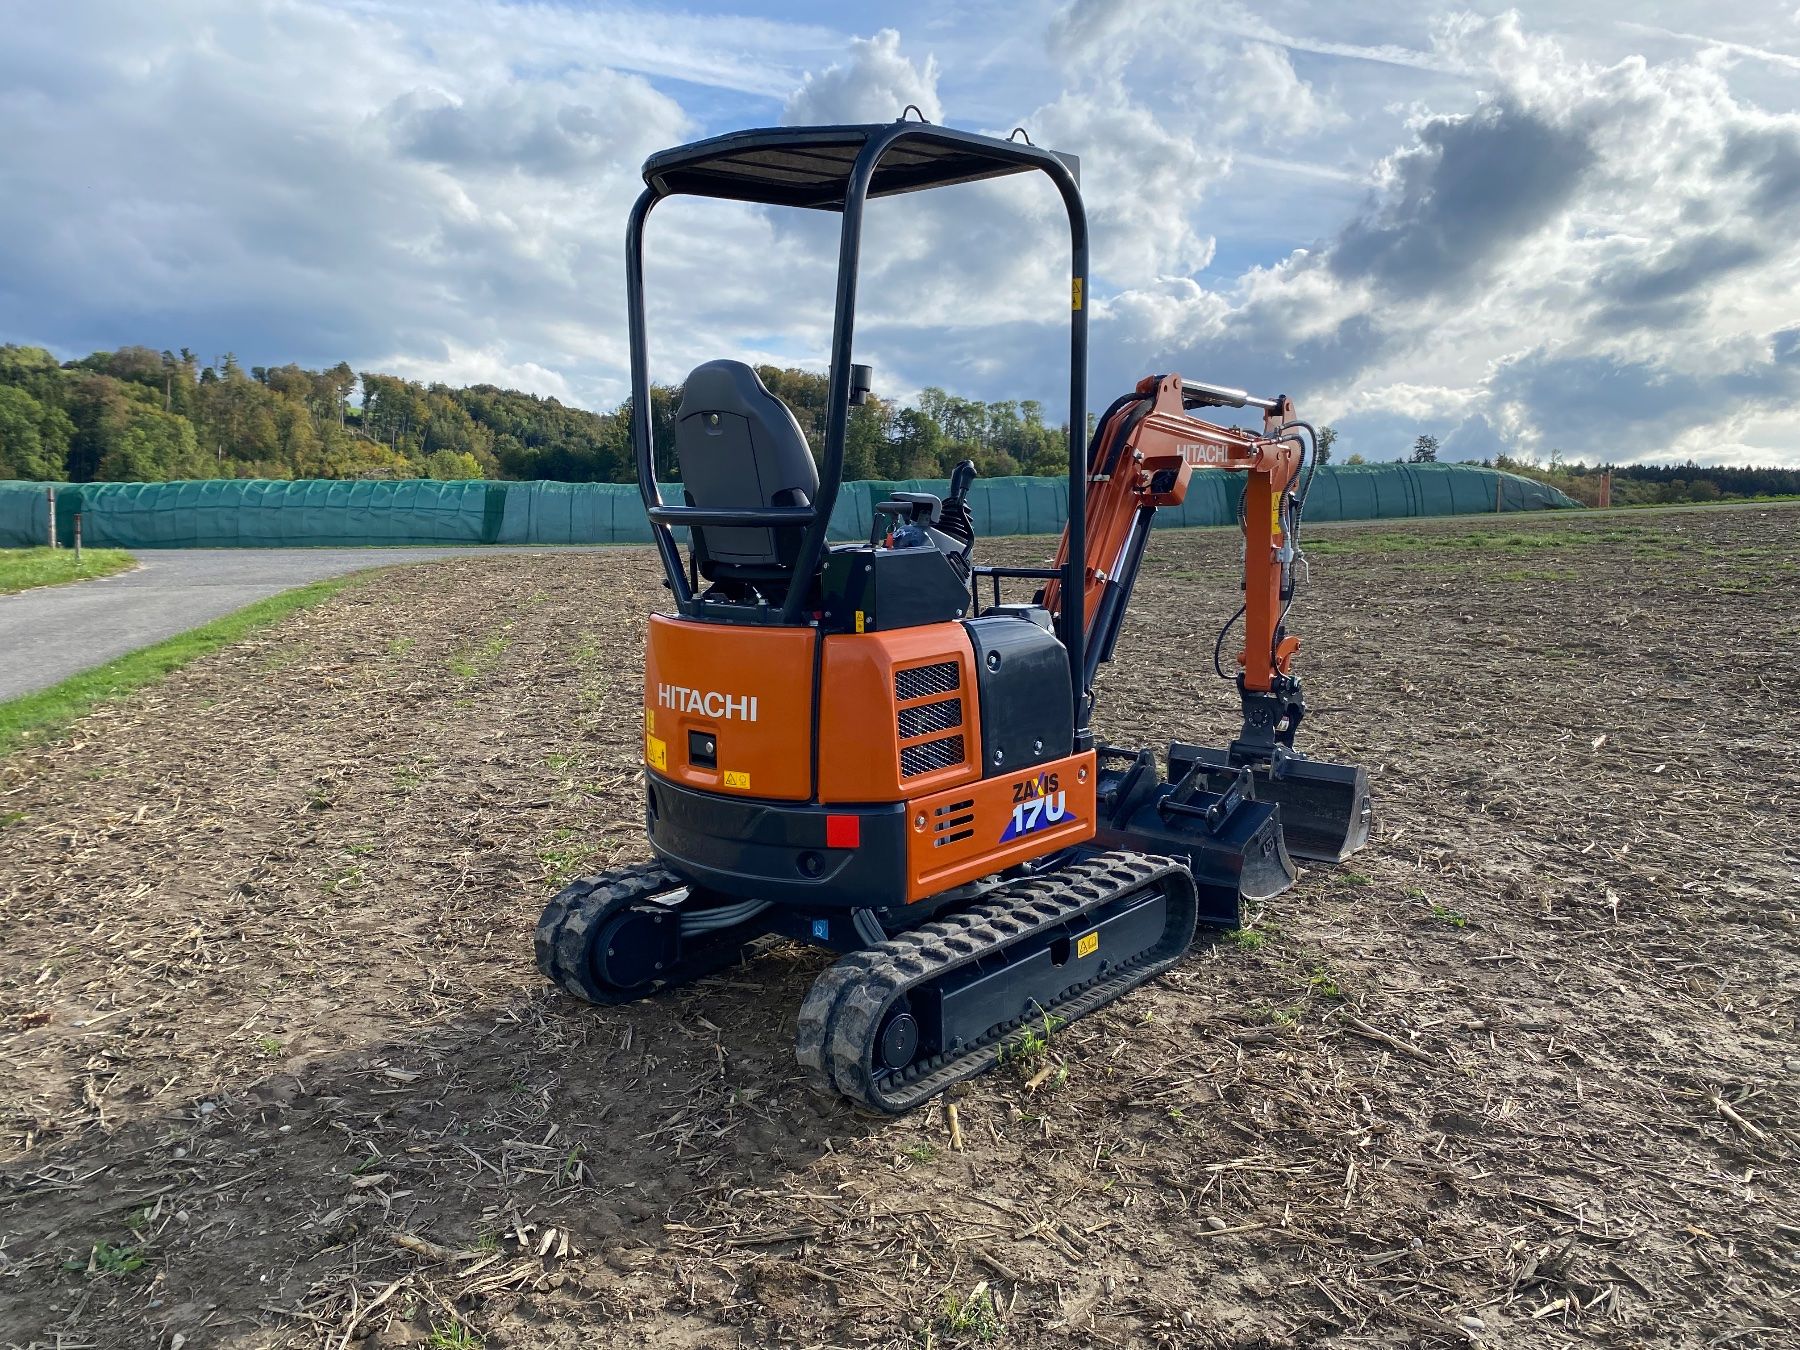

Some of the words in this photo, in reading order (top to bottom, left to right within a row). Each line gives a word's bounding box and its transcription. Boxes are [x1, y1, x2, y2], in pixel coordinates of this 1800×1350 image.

[1176, 444, 1229, 463] HITACHI
[658, 682, 757, 722] HITACHI
[1012, 772, 1059, 803] ZAXIS
[1012, 790, 1066, 833] 17U
